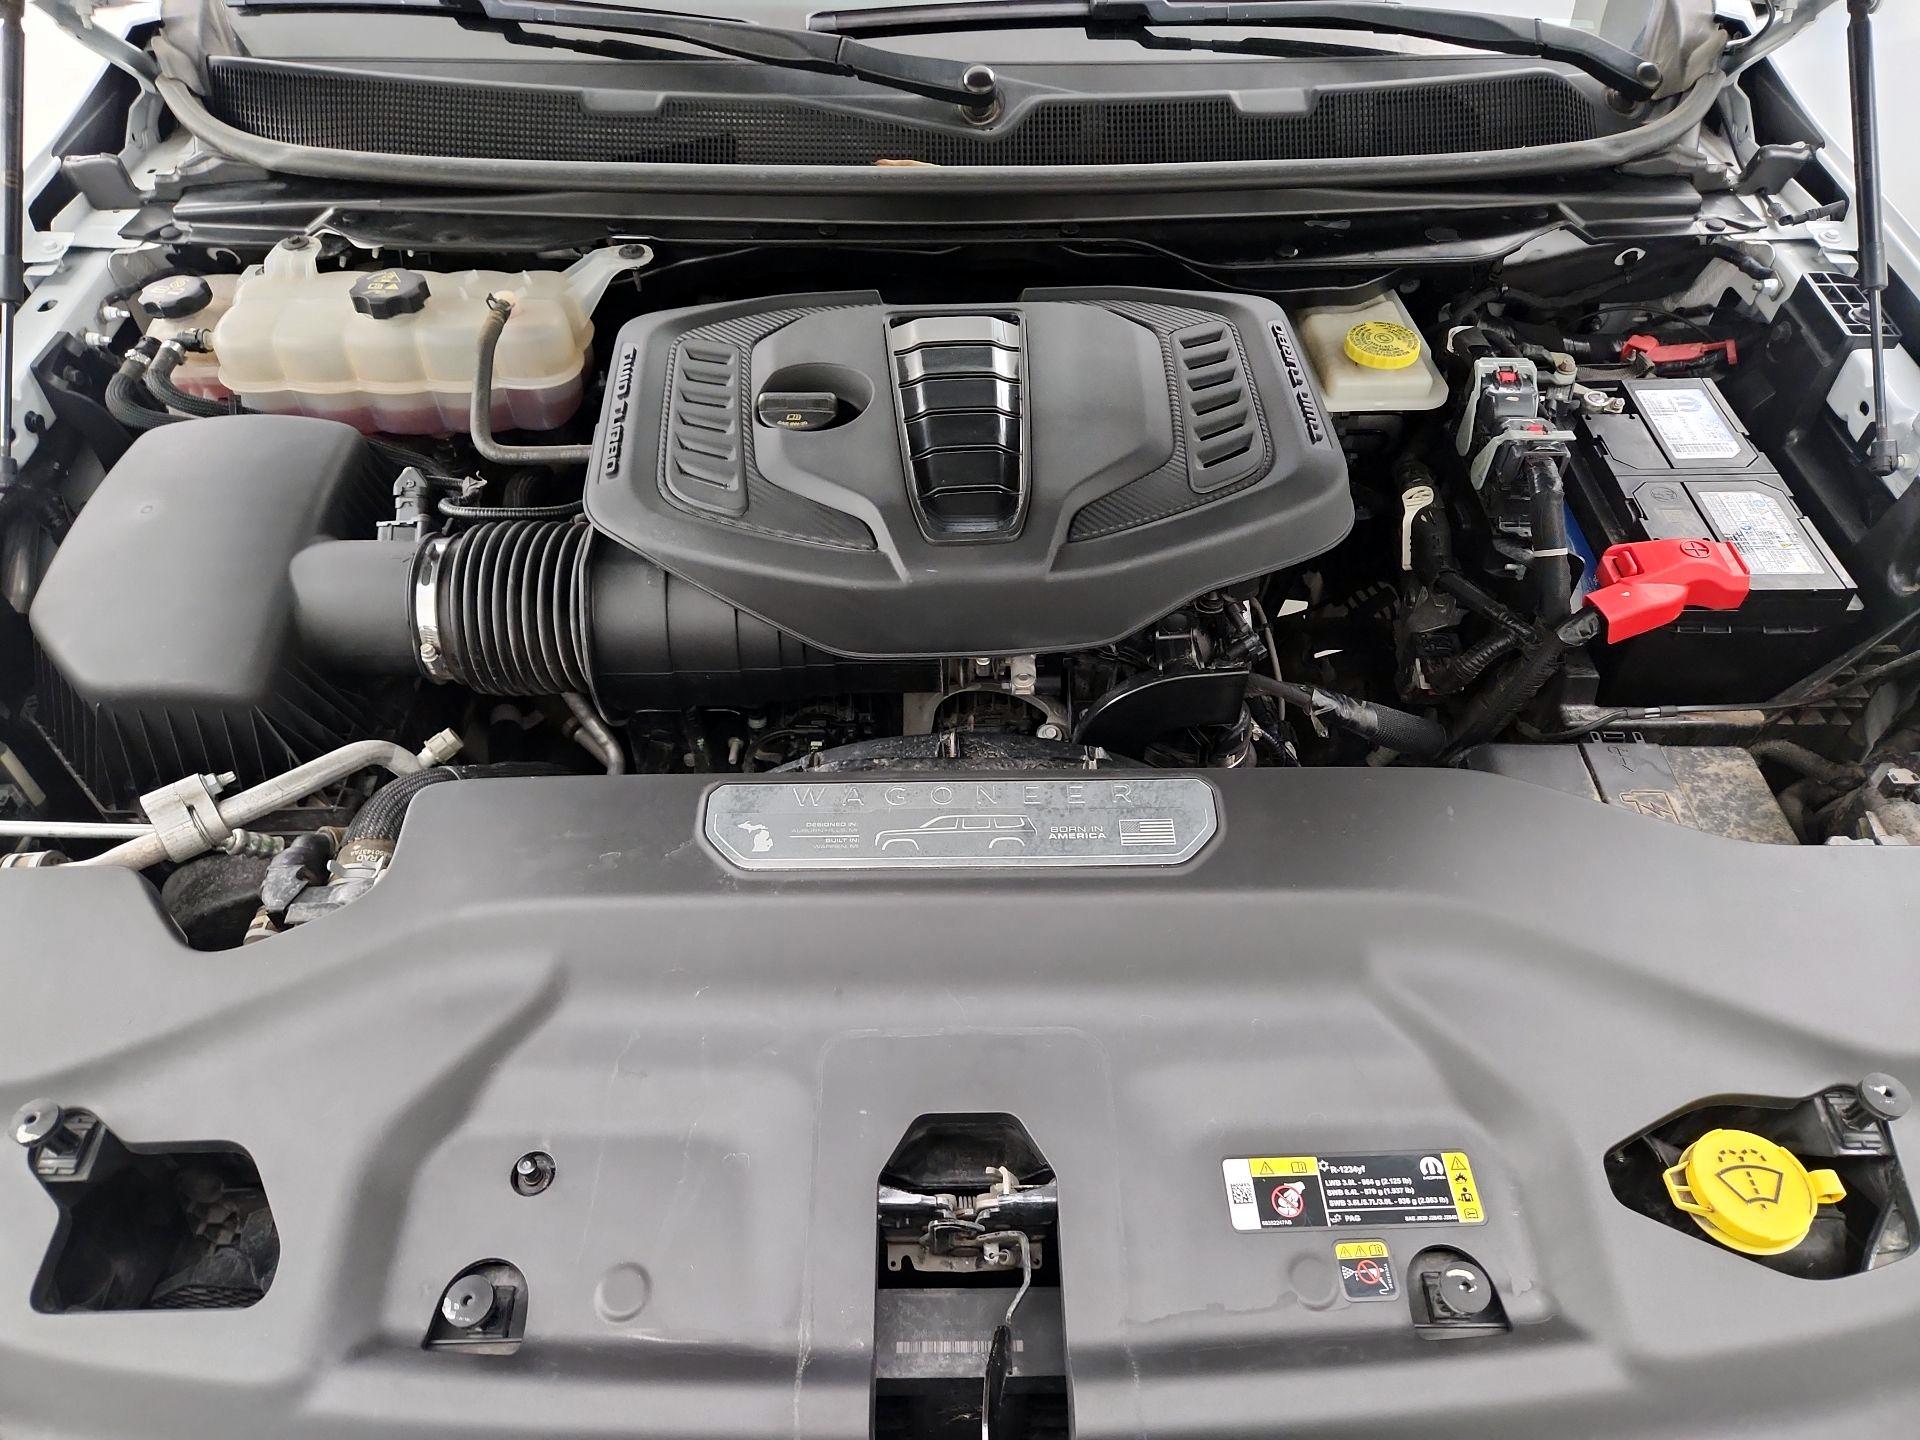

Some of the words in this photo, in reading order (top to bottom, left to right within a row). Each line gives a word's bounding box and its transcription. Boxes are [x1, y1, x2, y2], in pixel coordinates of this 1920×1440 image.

[1271, 324, 1303, 388] TURBO
[605, 400, 629, 479] TURBO
[793, 783, 1132, 806] WAGONEER
[1049, 832, 1107, 840] AMERICA
[356, 854, 378, 862] RAD
[1330, 1164, 1366, 1175] R-1234yf
[1324, 1179, 1342, 1187] LWB
[1375, 1179, 1381, 1187] g
[1381, 1177, 1402, 1186] (2.125
[1402, 1177, 1412, 1186] lb)
[1377, 1189, 1384, 1197] g
[1404, 1186, 1415, 1195] lb)
[1411, 1198, 1418, 1206] g
[1438, 1196, 1449, 1205] lb)
[1344, 1214, 1361, 1222] PAG
